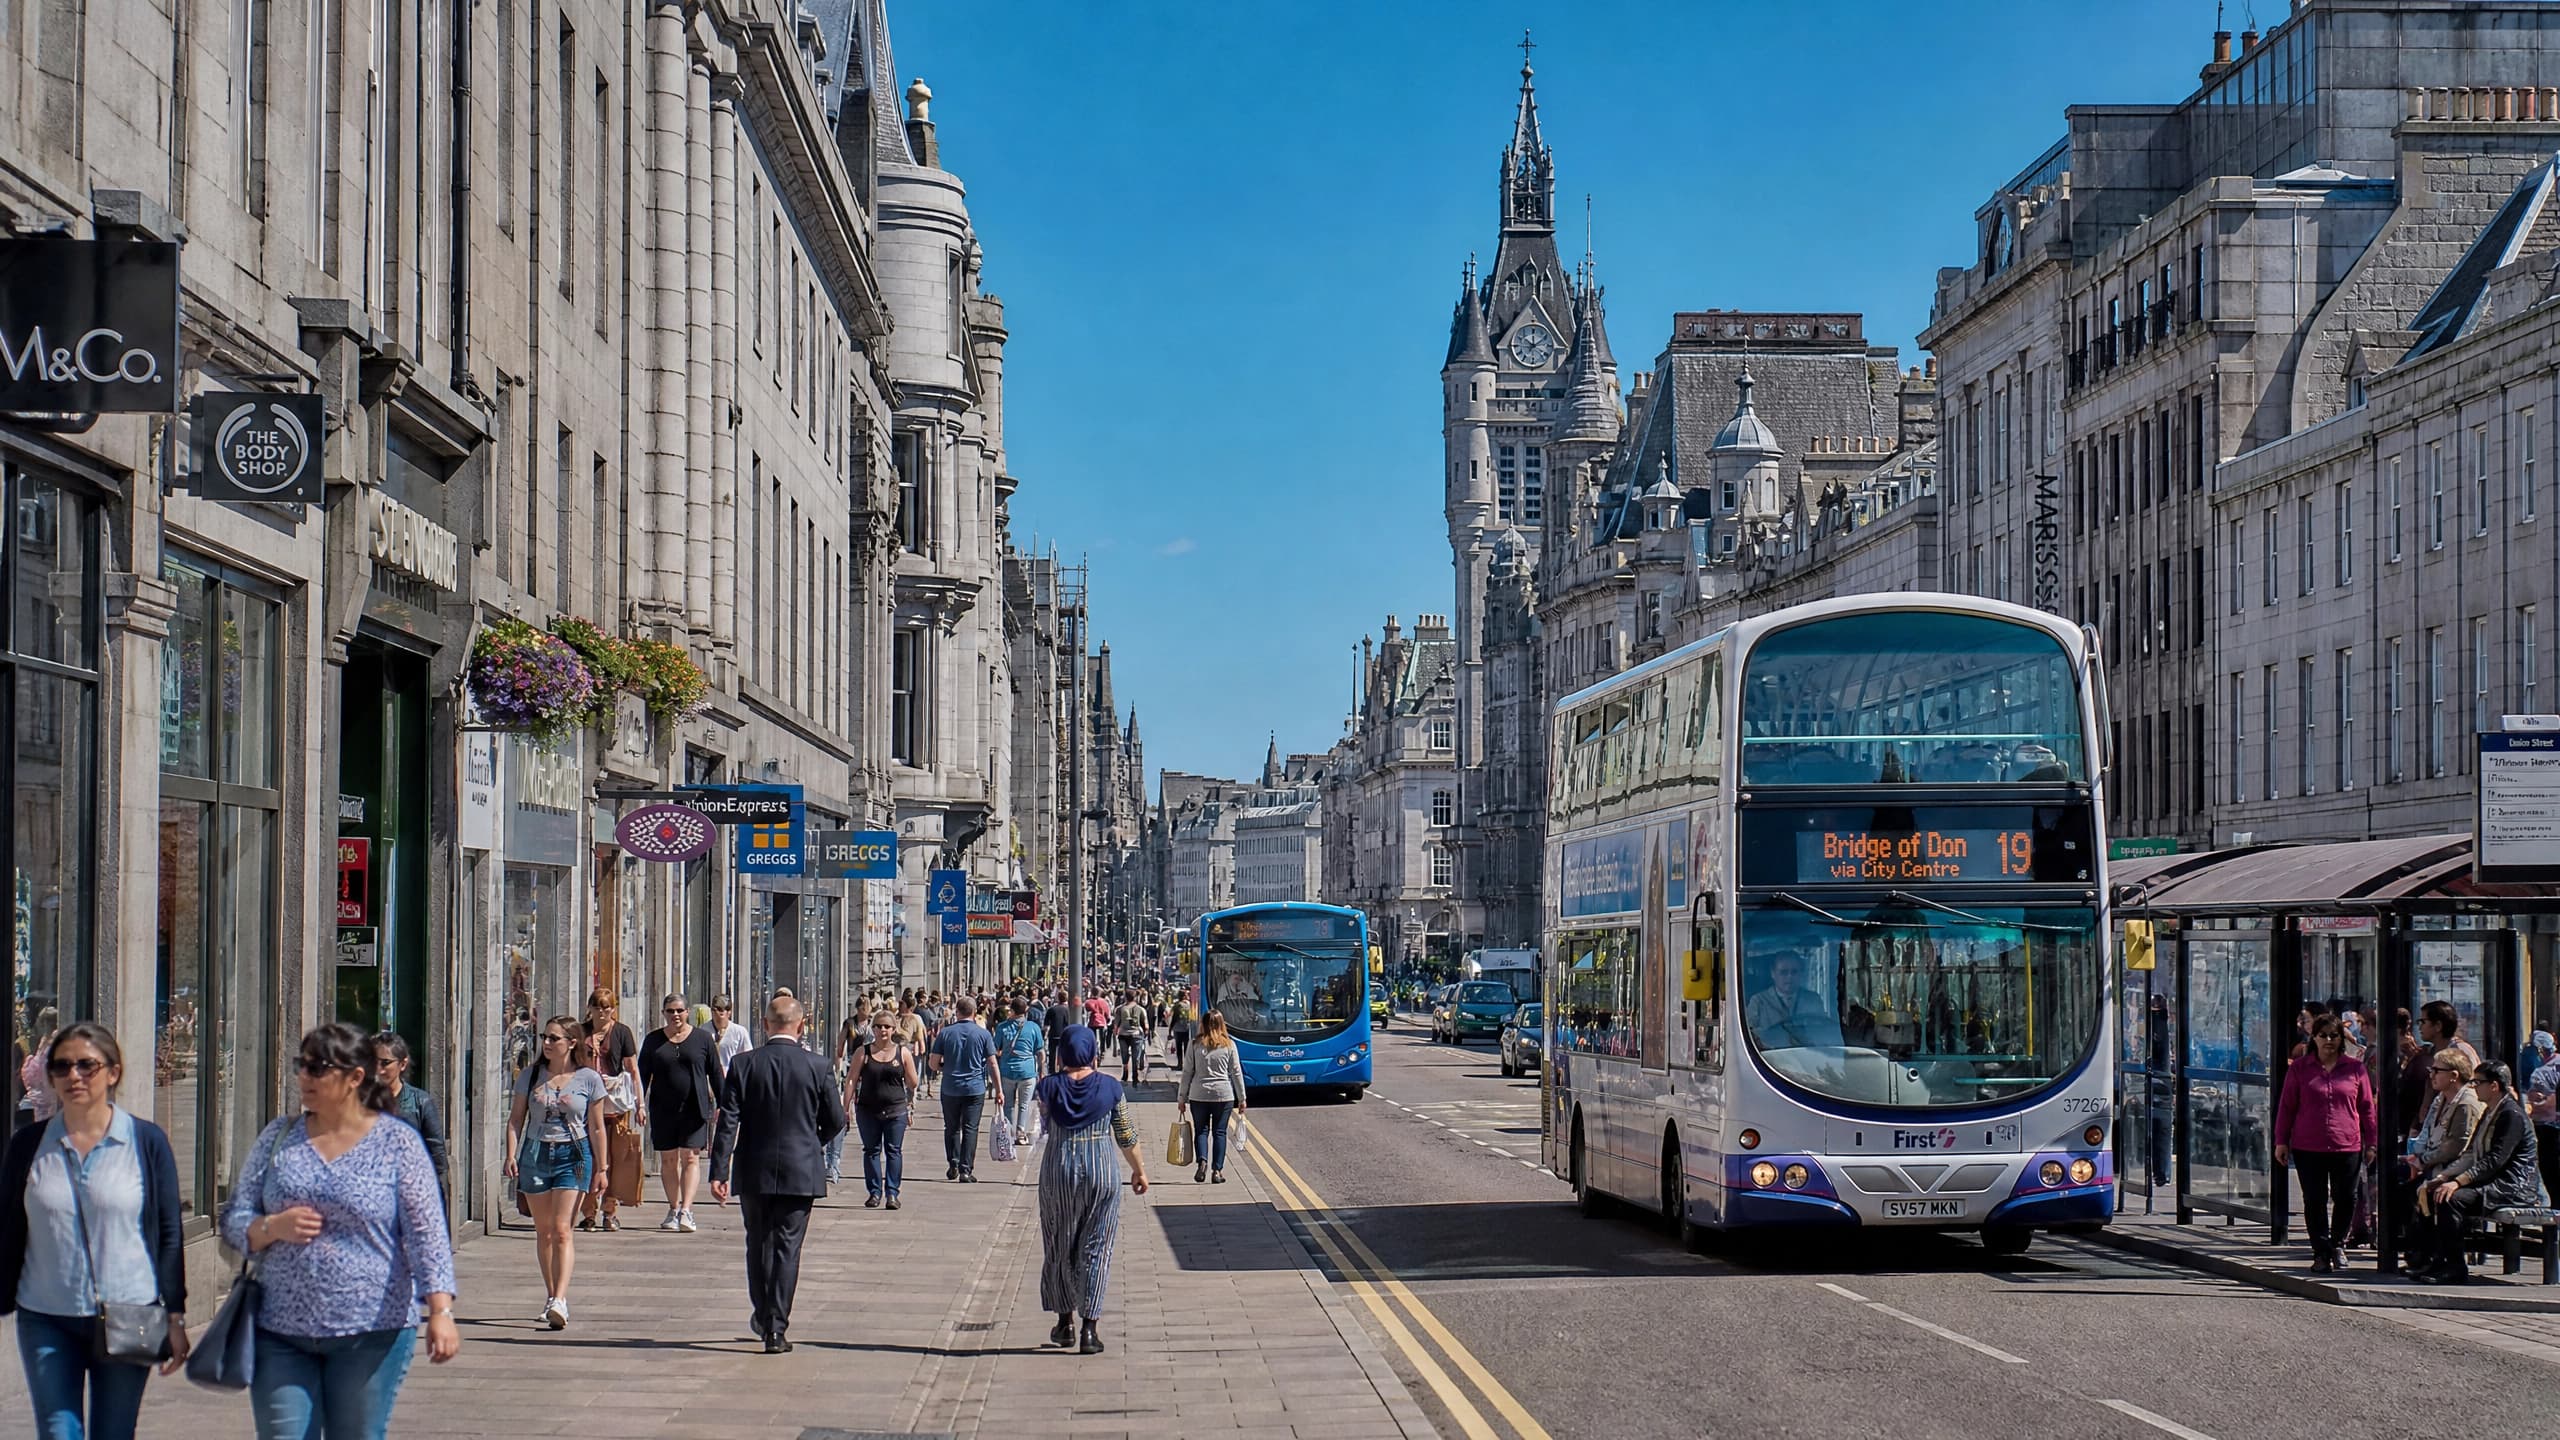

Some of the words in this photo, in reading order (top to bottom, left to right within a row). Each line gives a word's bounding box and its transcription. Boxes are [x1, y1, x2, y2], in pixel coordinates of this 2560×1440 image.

[0, 325, 162, 384] M&Co.
[246, 431, 279, 444] THE
[235, 445, 290, 459] BODY
[1824, 832, 1892, 861] Bridge
[1898, 832, 1921, 858] of
[1927, 832, 1967, 858] Don
[1997, 832, 2032, 874] 19
[746, 853, 797, 865] GREGGS
[1830, 861, 1856, 878] via
[1861, 861, 1896, 879] City
[1901, 861, 1960, 878] Centre
[2063, 1097, 2108, 1113] 37267
[1894, 1130, 1936, 1148] First
[1890, 1203, 1926, 1215] SV57
[1931, 1202, 1958, 1215] MKN
